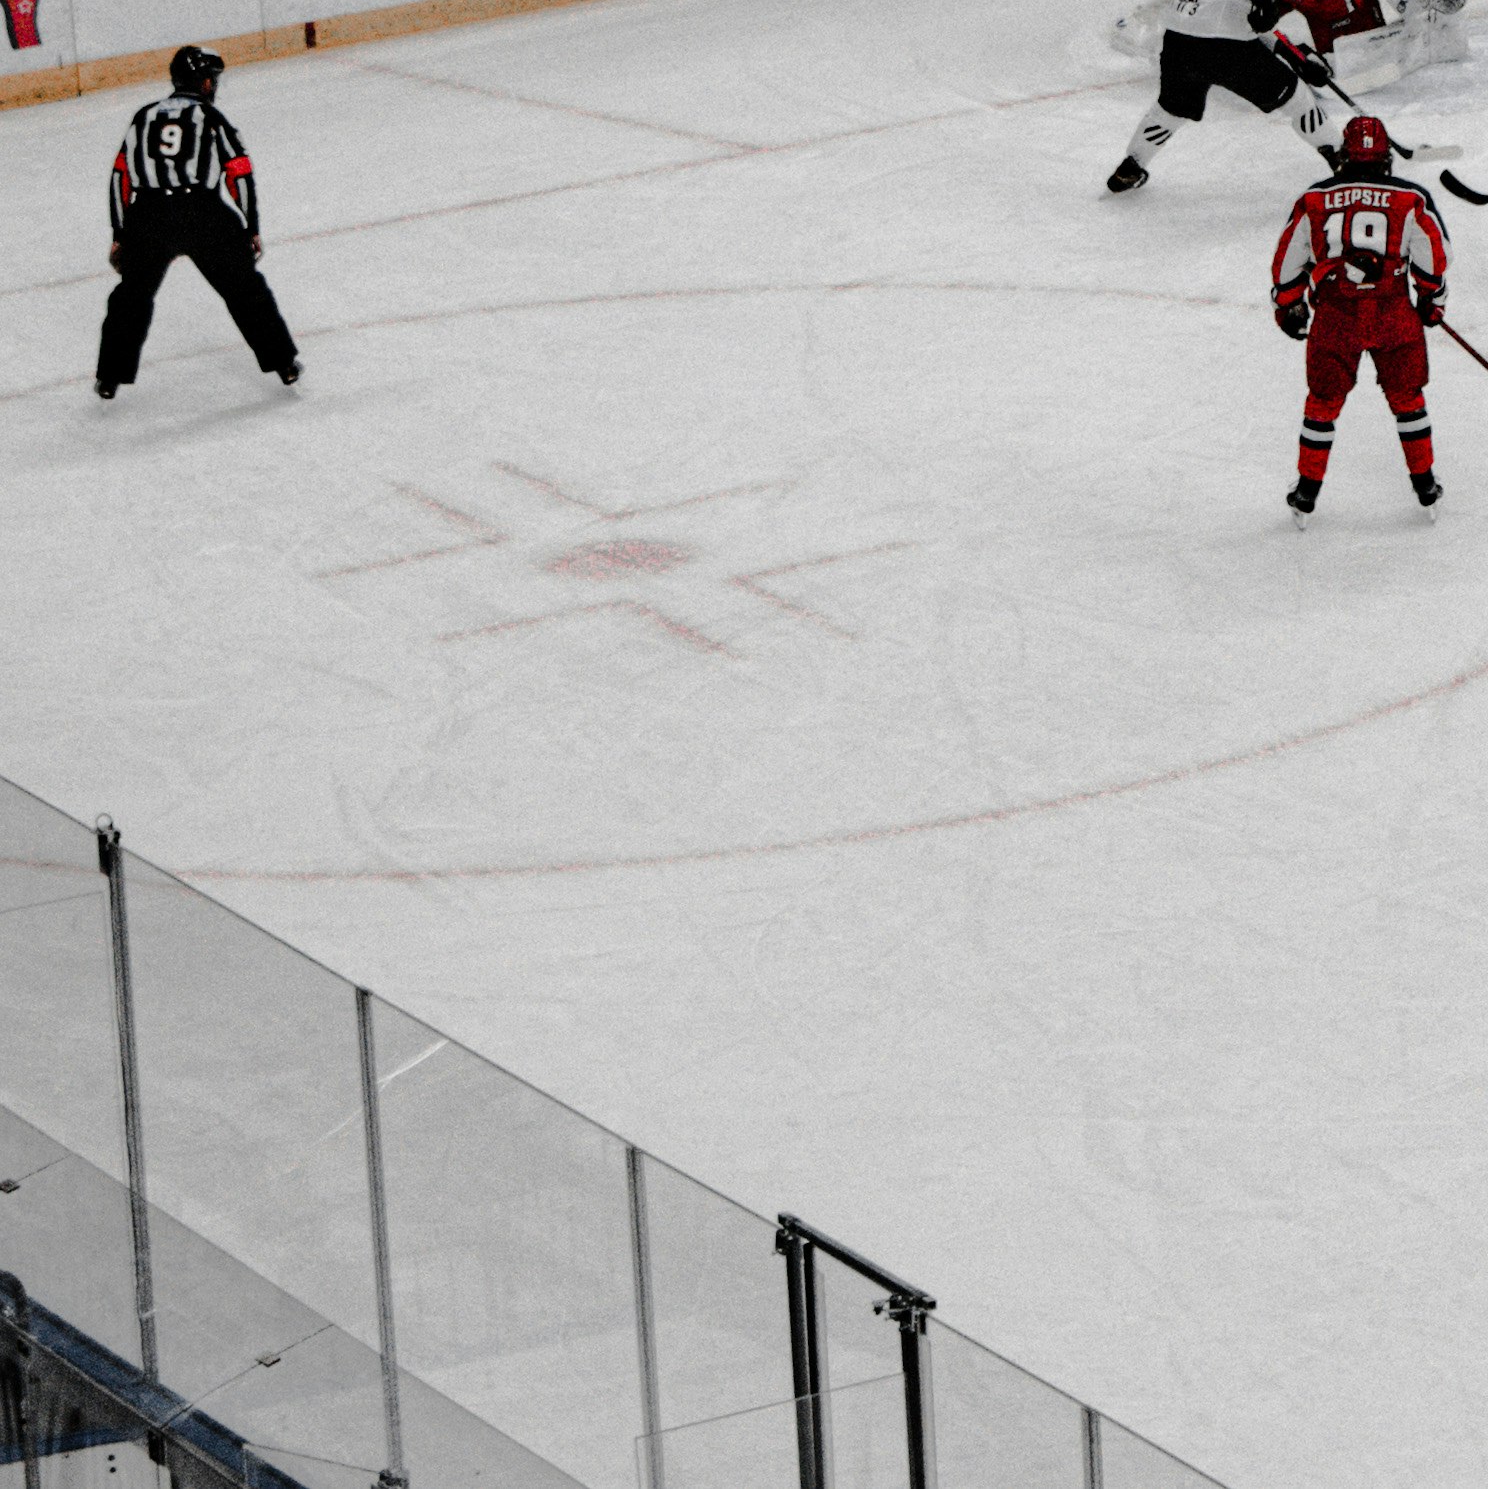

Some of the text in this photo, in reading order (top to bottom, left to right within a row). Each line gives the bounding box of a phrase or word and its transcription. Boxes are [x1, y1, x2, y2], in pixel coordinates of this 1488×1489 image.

[159, 123, 183, 157] 9
[1324, 189, 1392, 210] LEIPSIC
[1323, 210, 1388, 259] 19
